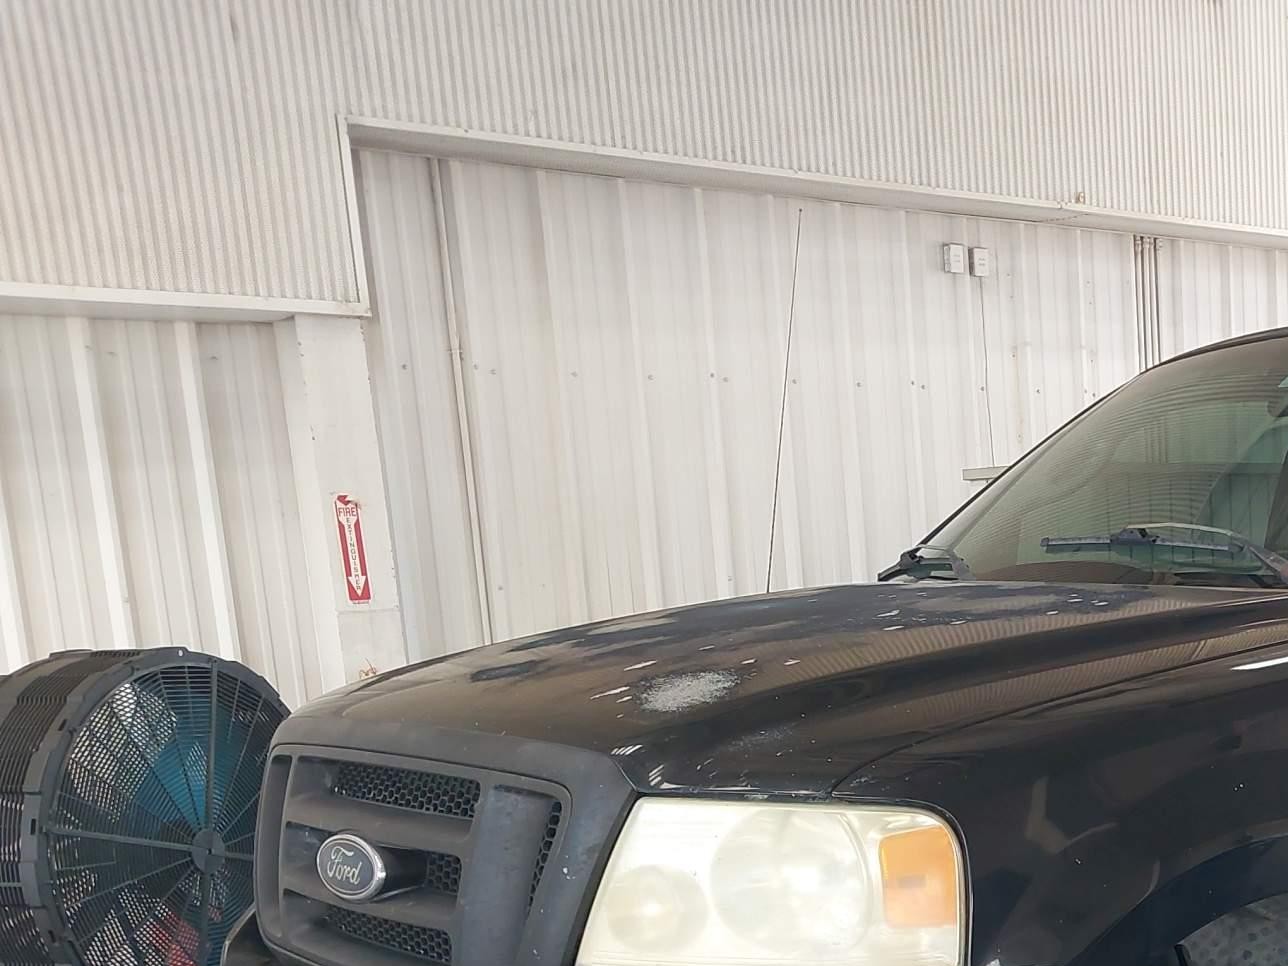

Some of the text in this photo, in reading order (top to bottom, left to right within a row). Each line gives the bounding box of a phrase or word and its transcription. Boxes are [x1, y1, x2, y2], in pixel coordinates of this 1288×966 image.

[338, 507, 357, 518] FIRE
[346, 517, 361, 590] EXTINGUISHER
[327, 846, 362, 885] Ford
